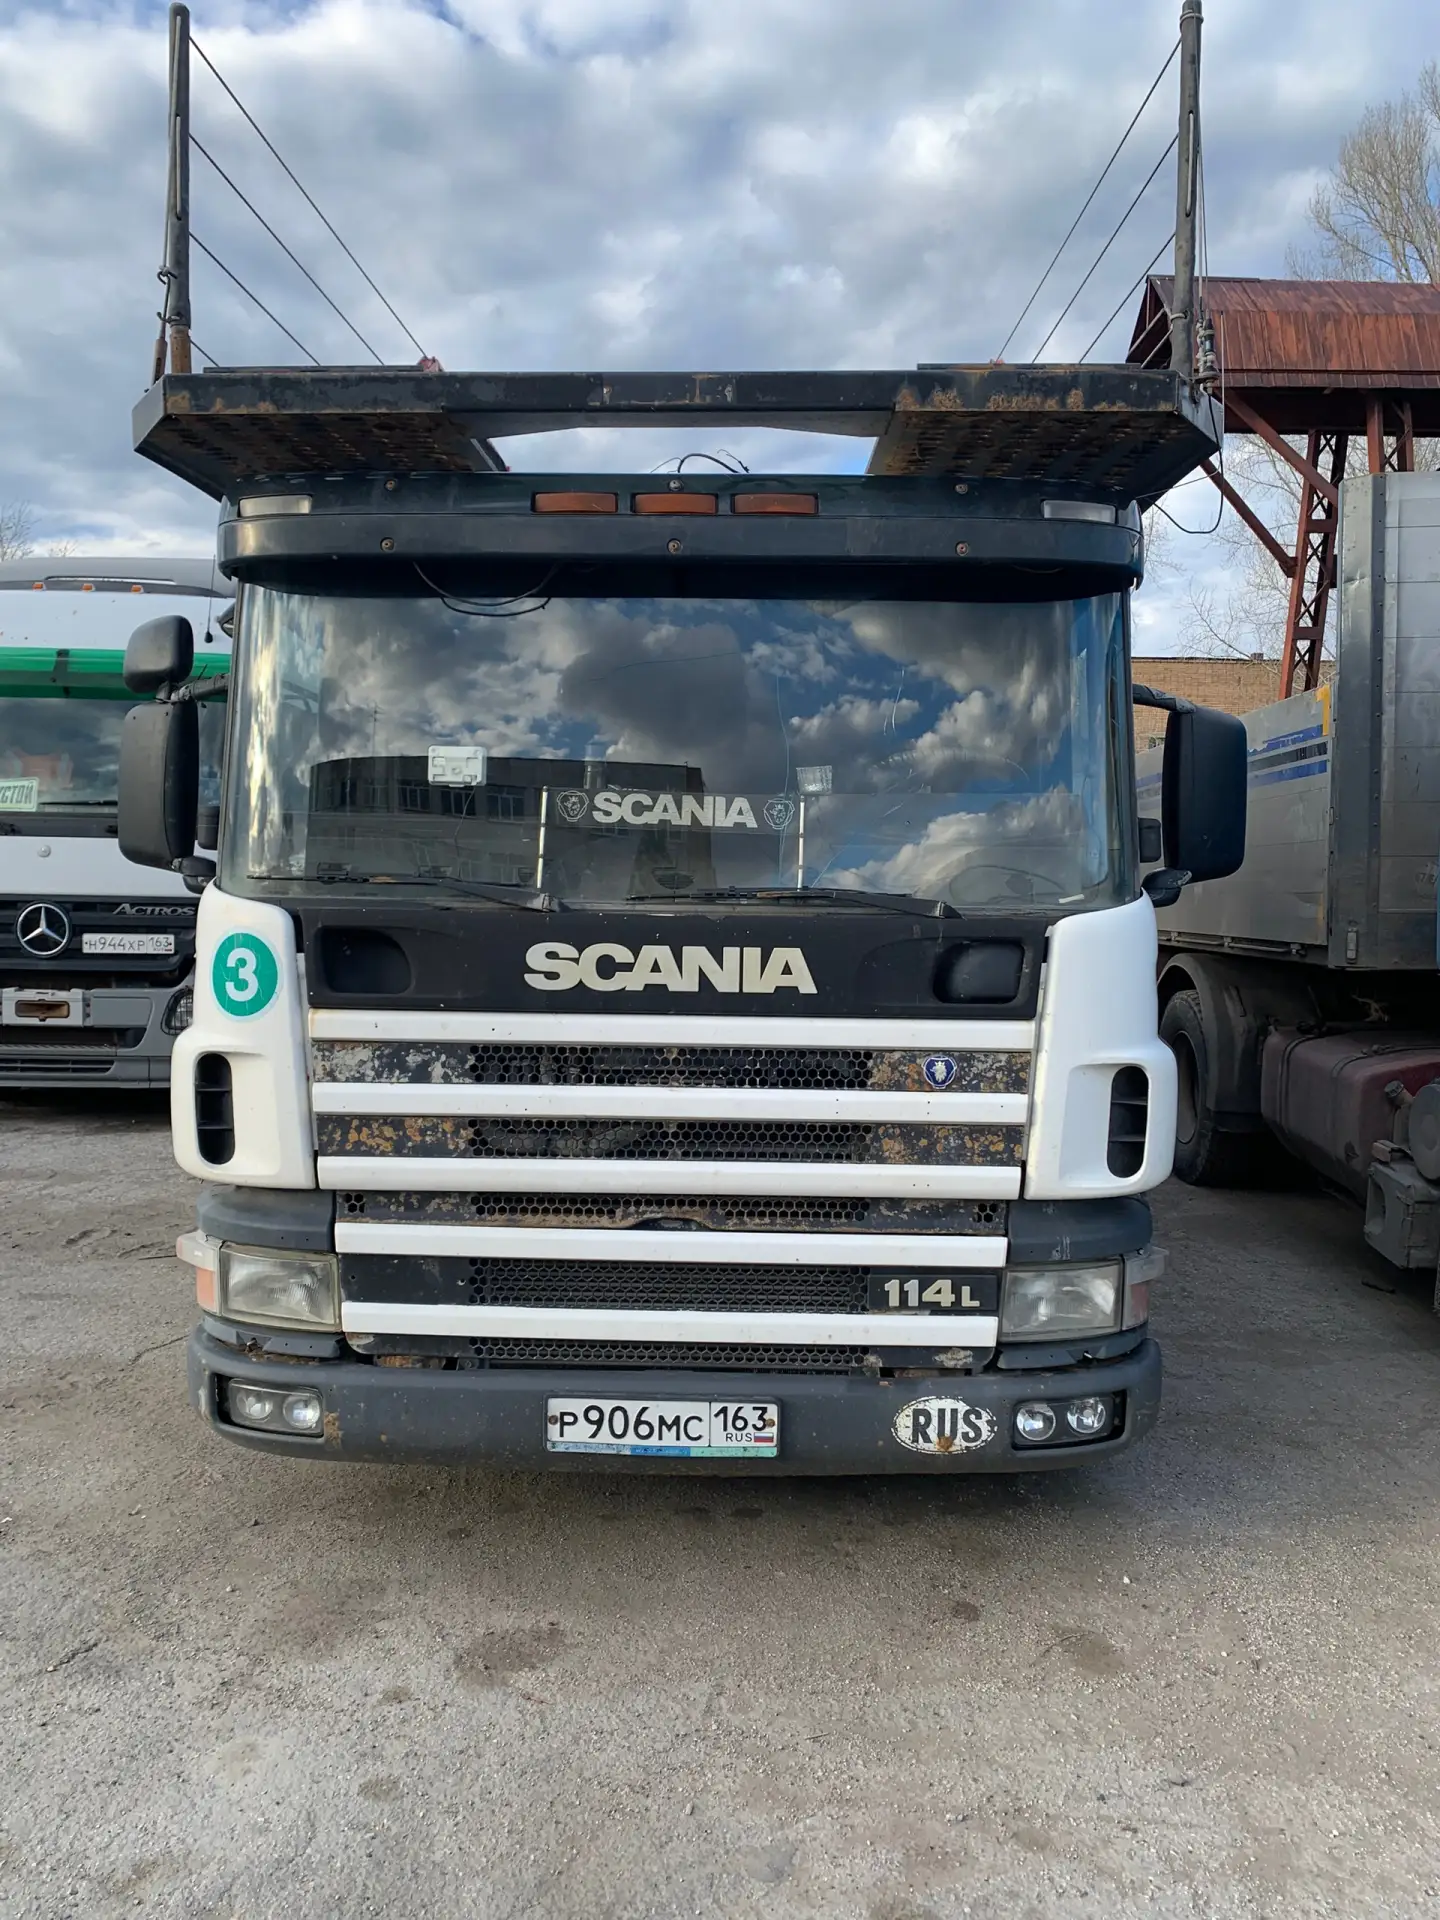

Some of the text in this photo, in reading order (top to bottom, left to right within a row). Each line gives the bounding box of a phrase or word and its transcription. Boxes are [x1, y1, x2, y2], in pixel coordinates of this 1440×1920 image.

[592, 792, 758, 828] SCANIA
[148, 937, 169, 947] 163
[225, 947, 259, 1002] 3
[523, 941, 818, 994] SCANIA
[713, 1405, 769, 1432] 163
[911, 1407, 983, 1444] RUS
[725, 1432, 753, 1443] RUS
